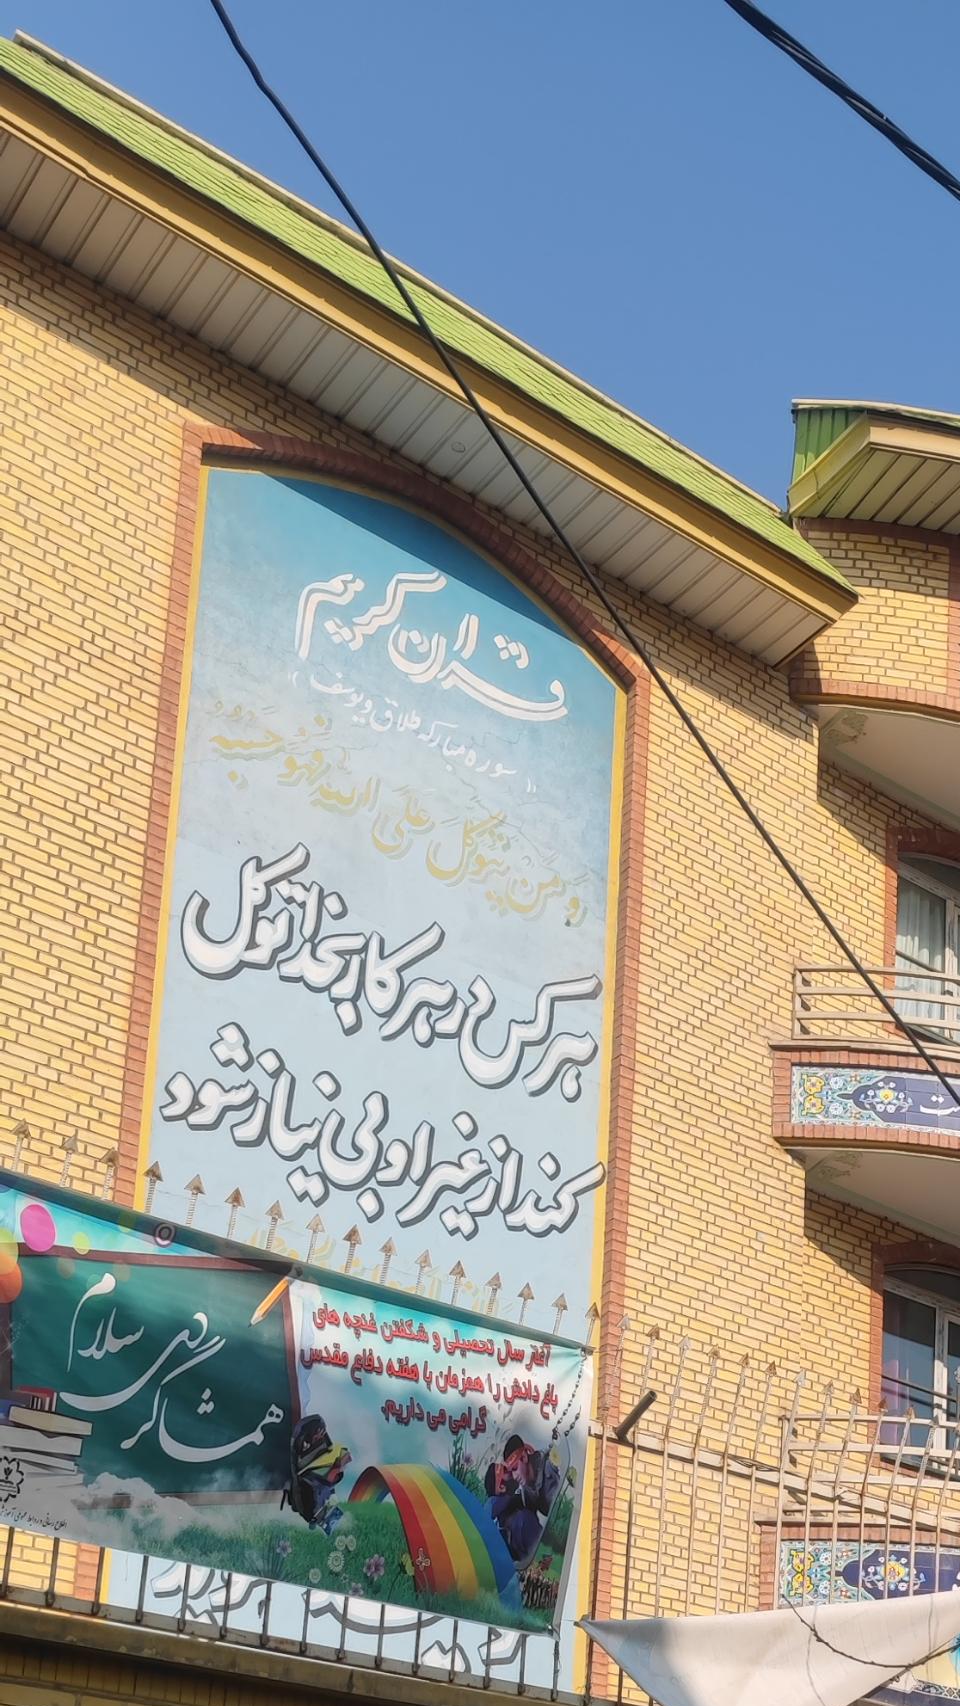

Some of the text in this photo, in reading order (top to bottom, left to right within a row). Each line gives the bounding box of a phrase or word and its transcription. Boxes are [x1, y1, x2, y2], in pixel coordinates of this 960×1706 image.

[295, 572, 447, 660] کریم
[369, 697, 421, 732] طلاق
[417, 720, 467, 772] مبارکه
[466, 750, 517, 778] سوره
[67, 1271, 145, 1373] سلام
[312, 1303, 552, 1372] آغاز سال تحصیلی و شکفتن غنچه های
[300, 1342, 559, 1421] باغ دانش را همزمان با هفته دفاع مقدس
[426, 1408, 447, 1432] می
[448, 1405, 487, 1439] گرامی
